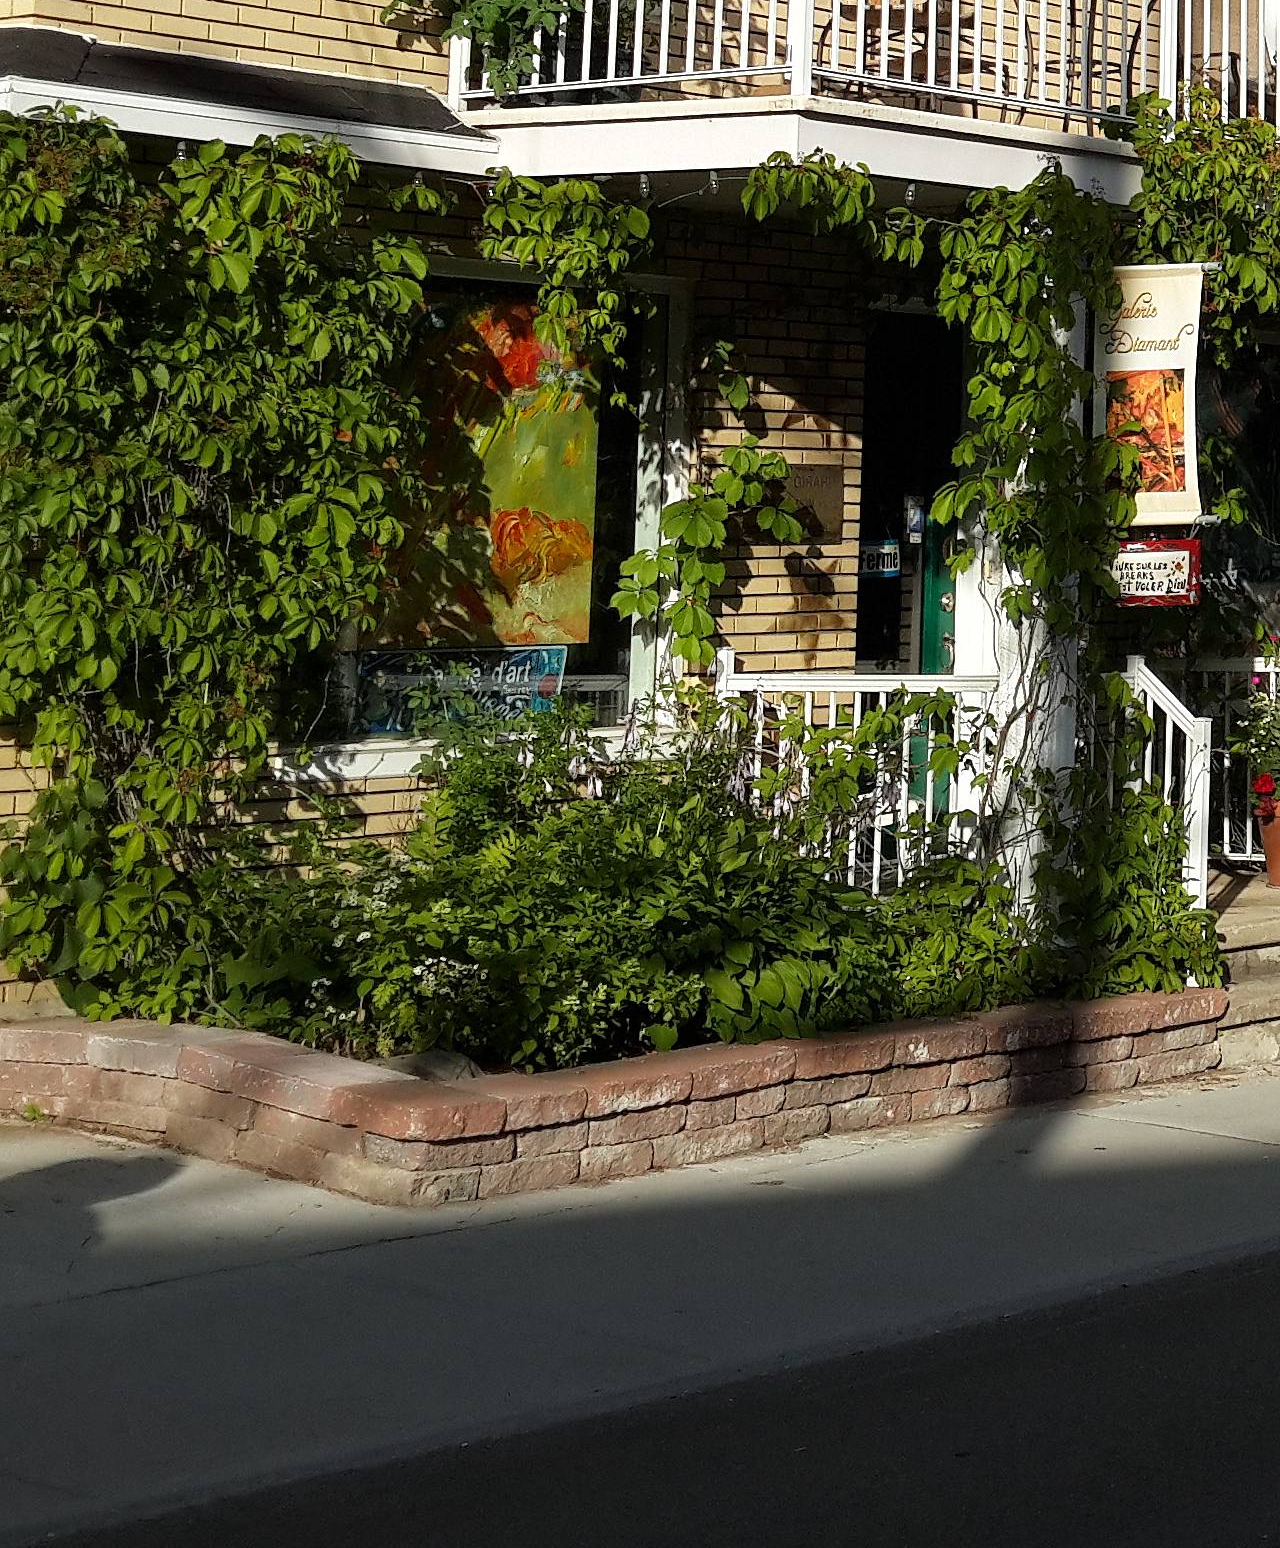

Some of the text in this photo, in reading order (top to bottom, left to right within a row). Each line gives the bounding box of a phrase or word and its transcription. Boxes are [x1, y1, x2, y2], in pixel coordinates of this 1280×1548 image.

[1099, 292, 1158, 334] Galerie
[1105, 323, 1194, 354] Diamant
[492, 660, 532, 684] d'art
